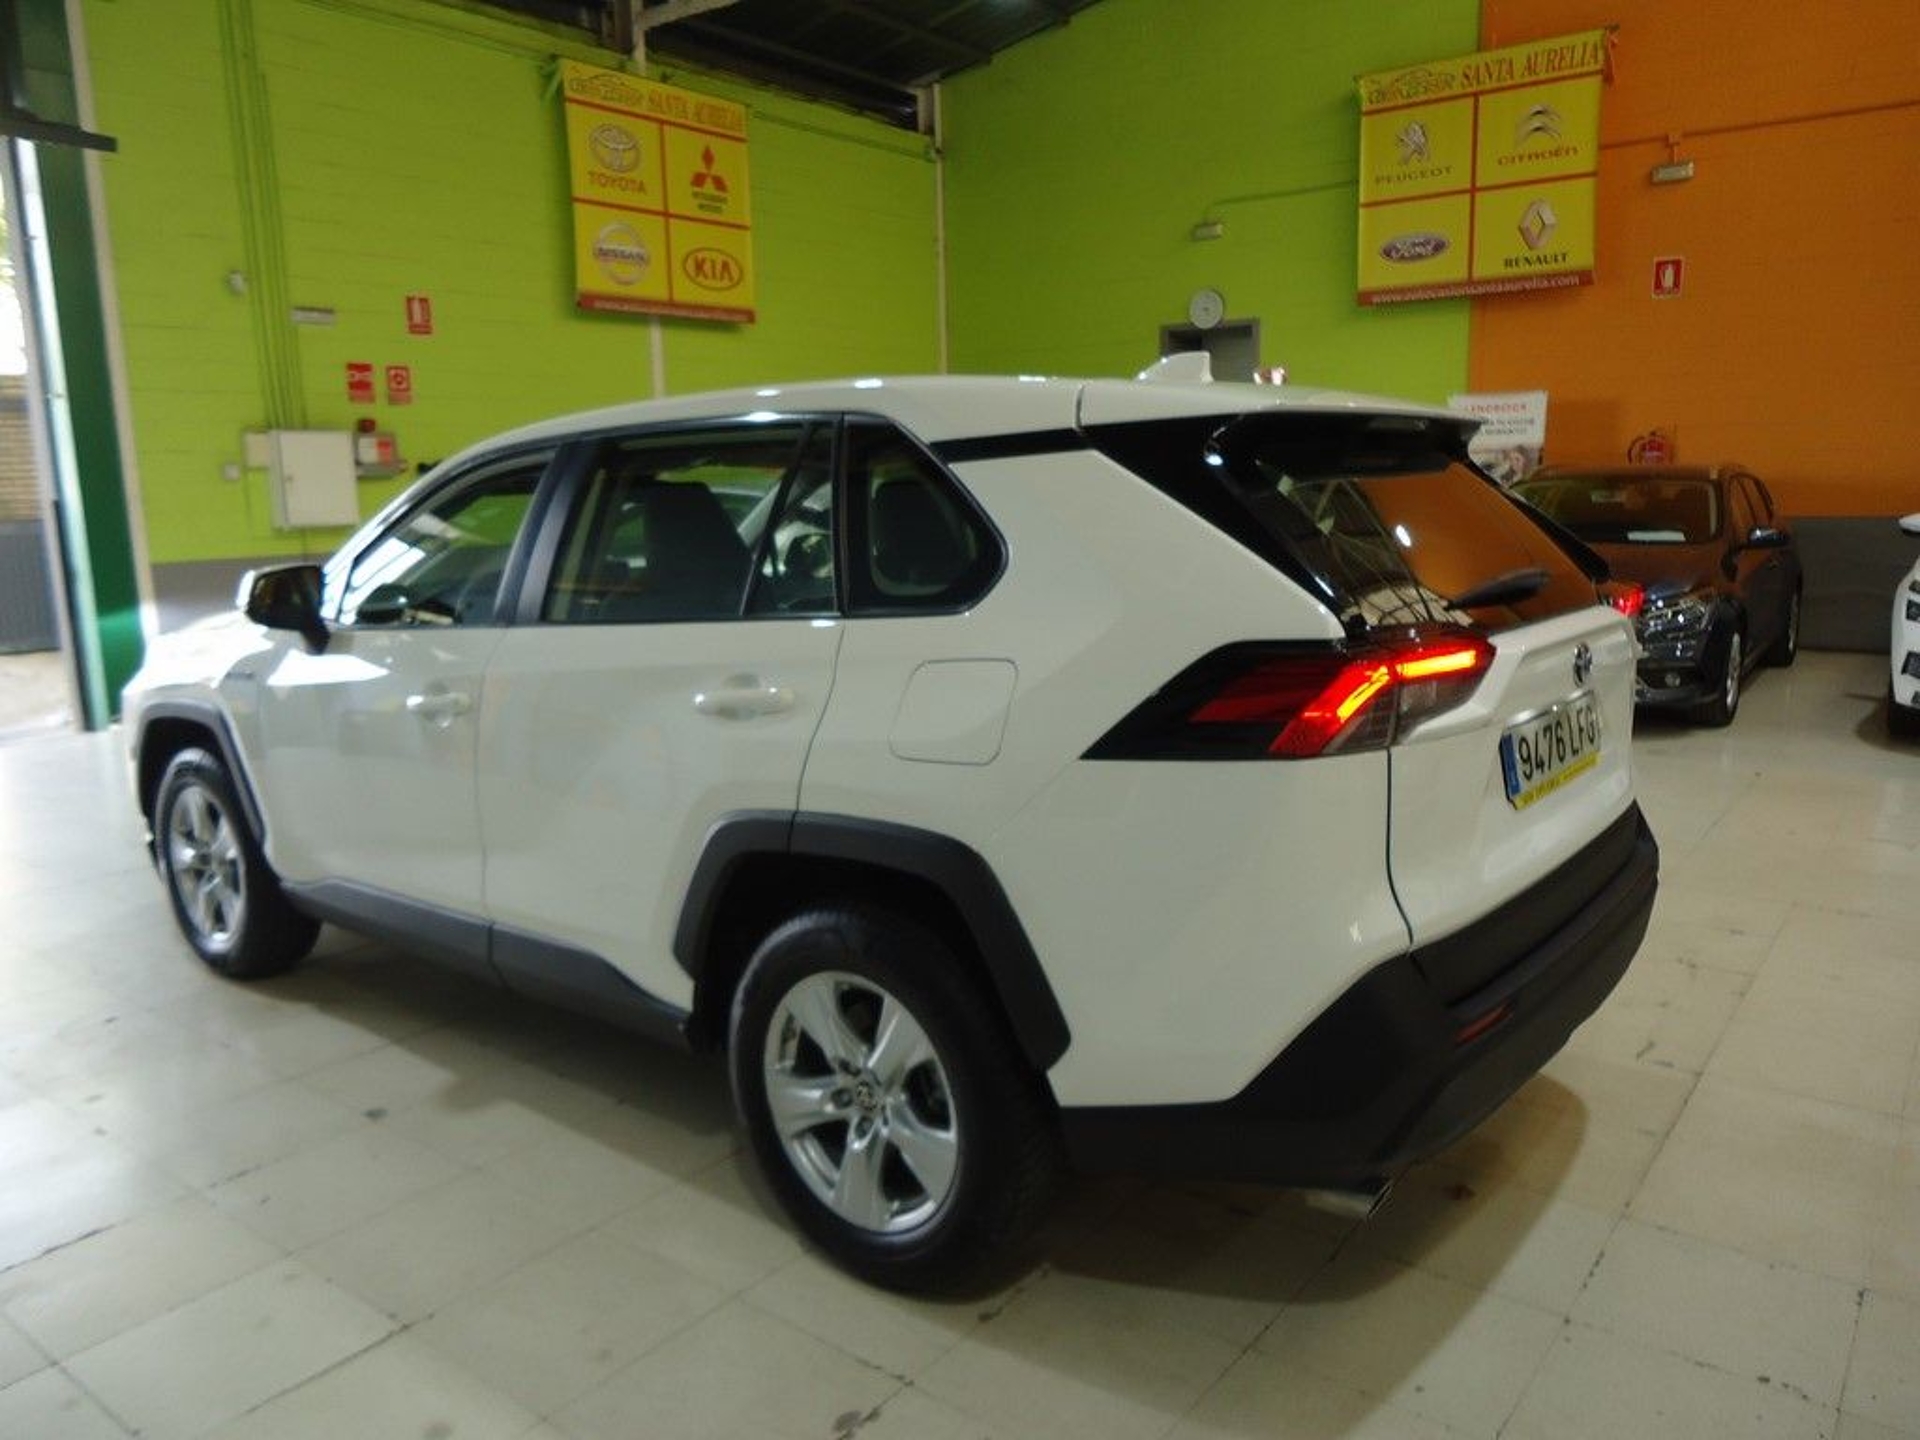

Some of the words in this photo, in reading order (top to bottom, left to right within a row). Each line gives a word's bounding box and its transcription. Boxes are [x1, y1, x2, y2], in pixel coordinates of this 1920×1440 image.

[1458, 57, 1515, 90] SANTA
[1521, 41, 1600, 79] AURELIA
[588, 170, 648, 195] TOYOTA
[1374, 164, 1453, 186] PEUGEOT
[694, 260, 735, 283] KIA
[1503, 250, 1569, 269] RENAULT
[1518, 719, 1566, 781] 9476
[1567, 705, 1596, 757] LFG
